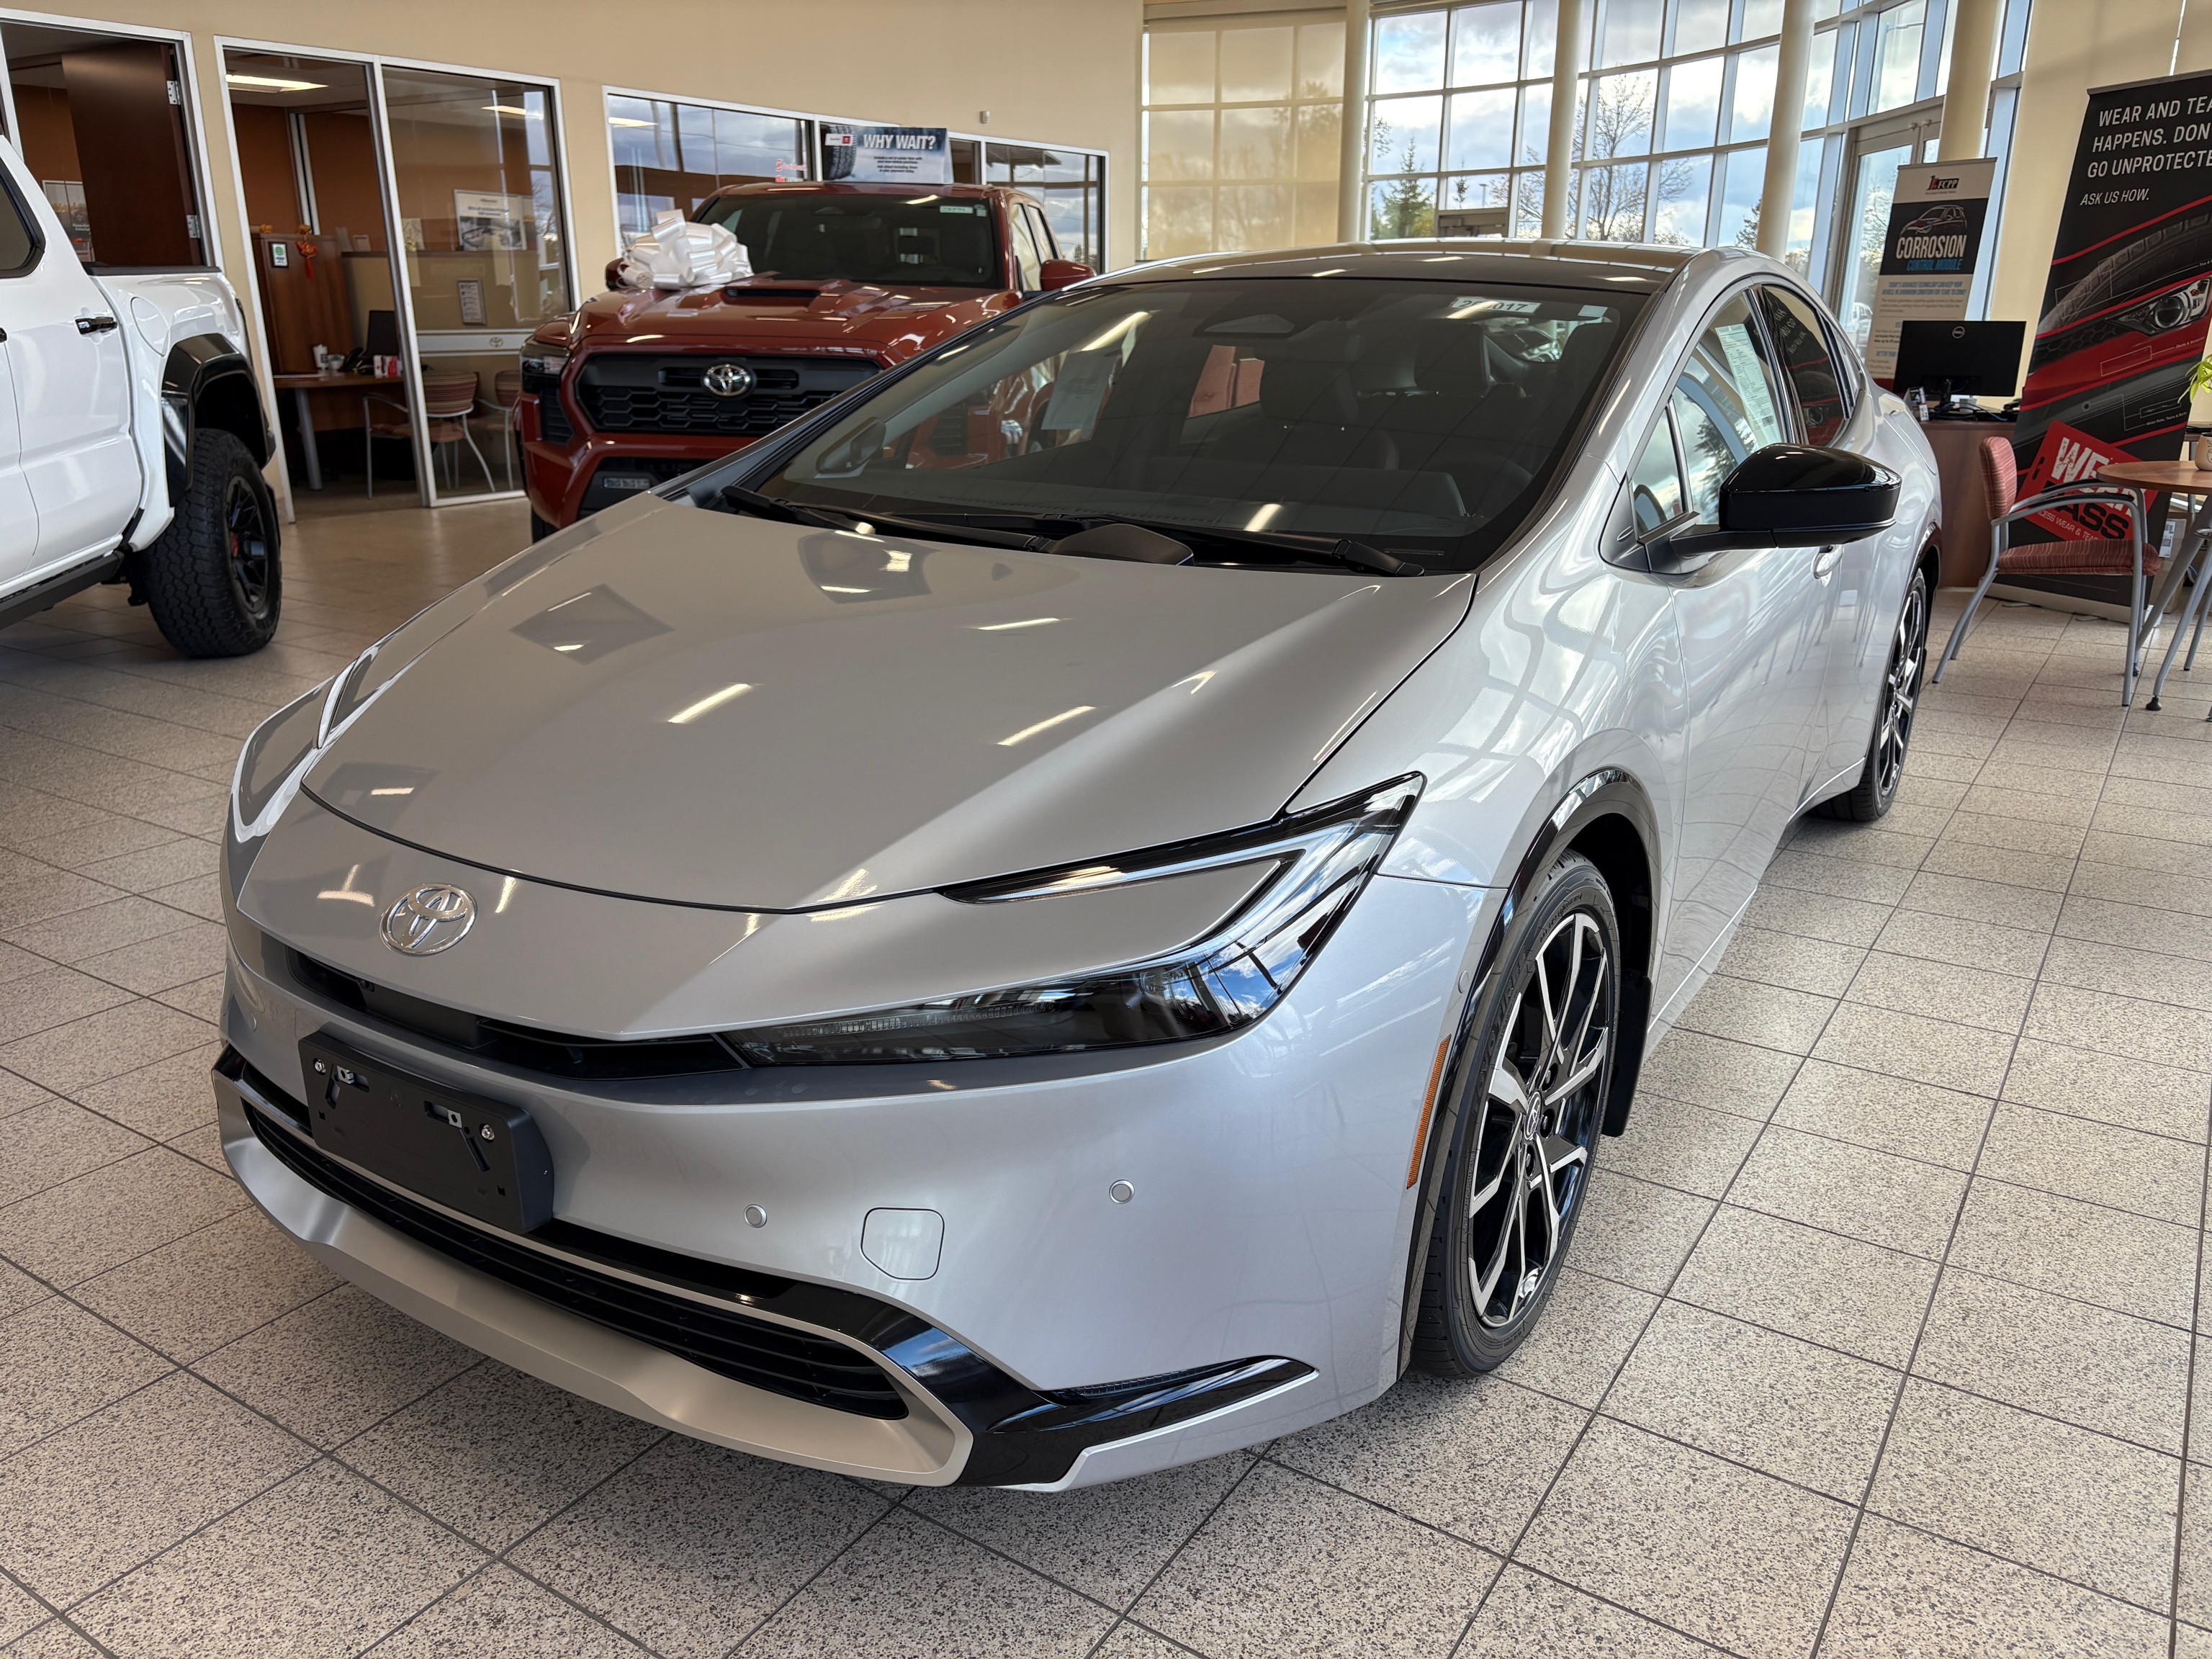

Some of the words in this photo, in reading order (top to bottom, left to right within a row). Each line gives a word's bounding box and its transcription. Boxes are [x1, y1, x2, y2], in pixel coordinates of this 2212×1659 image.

[2099, 106, 2141, 127] WEAR
[2146, 100, 2180, 120] AND
[864, 134, 894, 149] WHY
[896, 135, 936, 150] WAIT?
[2092, 128, 2167, 153] HAPPENS.
[2087, 161, 2108, 178] GO
[2080, 192, 2103, 206] ASK
[2104, 191, 2119, 204] US
[2121, 188, 2149, 202] HOW.
[1896, 235, 1967, 259] CORROSION
[1459, 300, 1528, 311] 2017
[2056, 516, 2074, 533] WEAR
[2075, 527, 2080, 536] &
